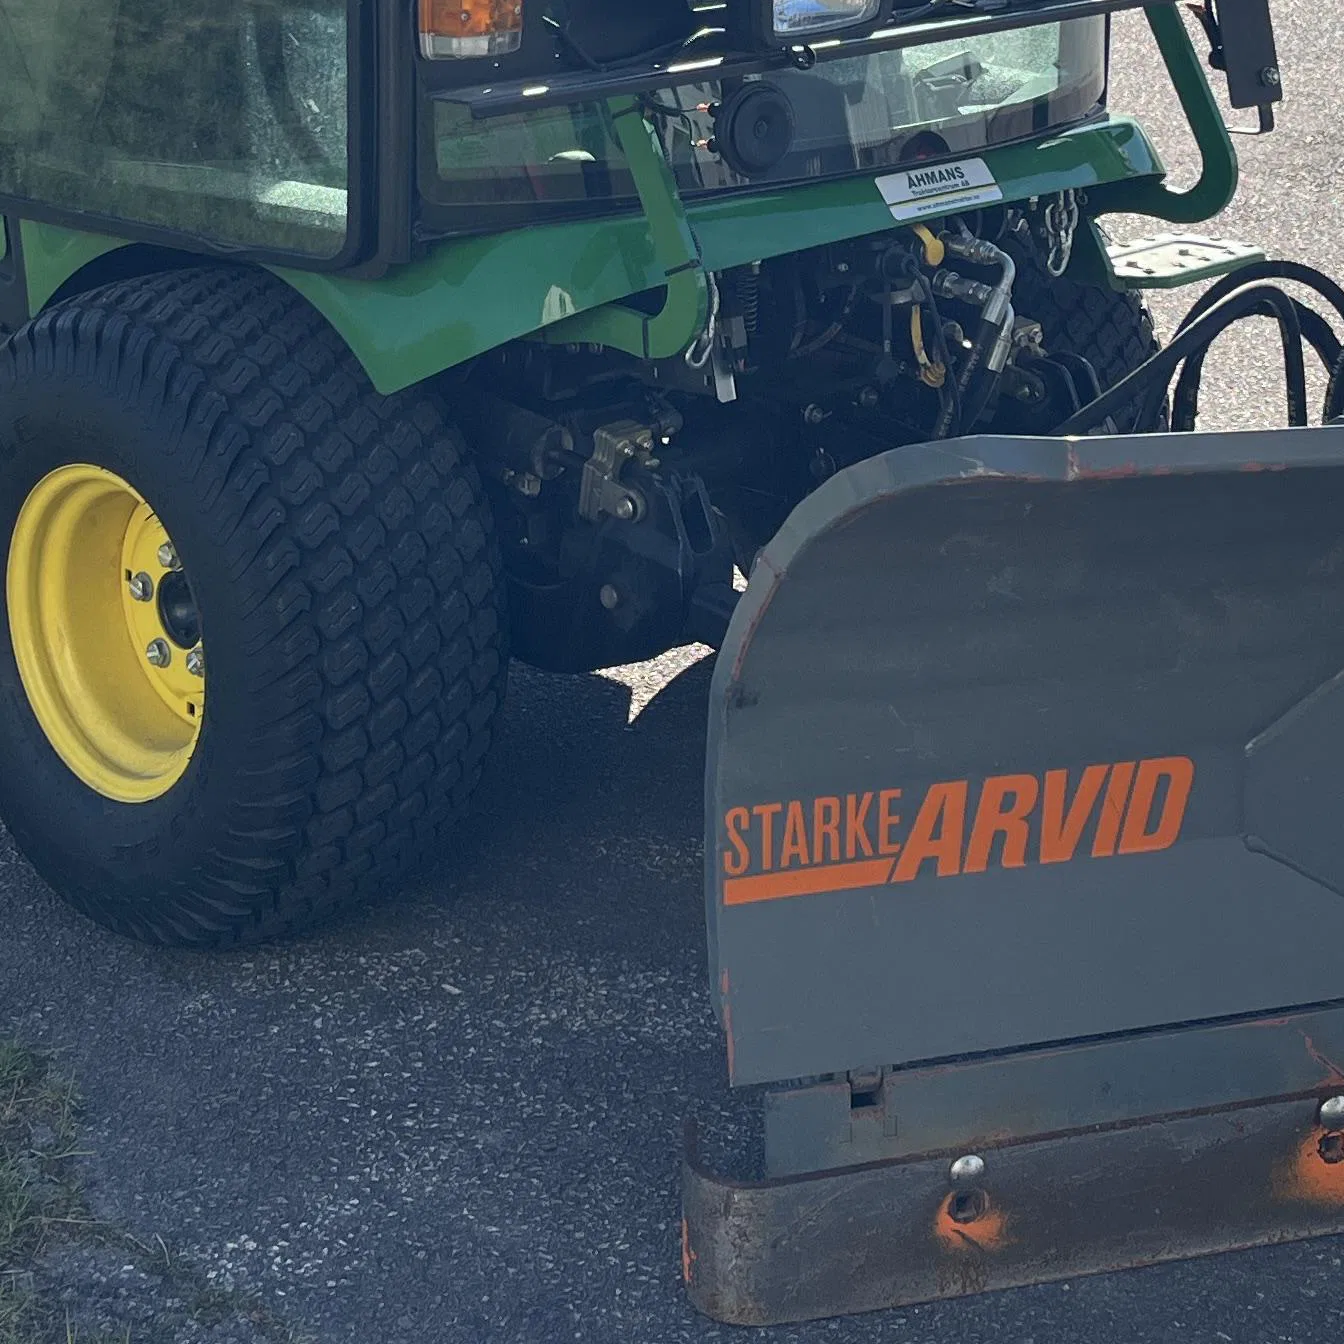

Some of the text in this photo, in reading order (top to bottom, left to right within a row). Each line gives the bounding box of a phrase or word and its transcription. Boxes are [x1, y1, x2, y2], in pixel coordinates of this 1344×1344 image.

[907, 166, 965, 189] ÅHMANS
[723, 755, 1195, 883] STARKE ARVID
